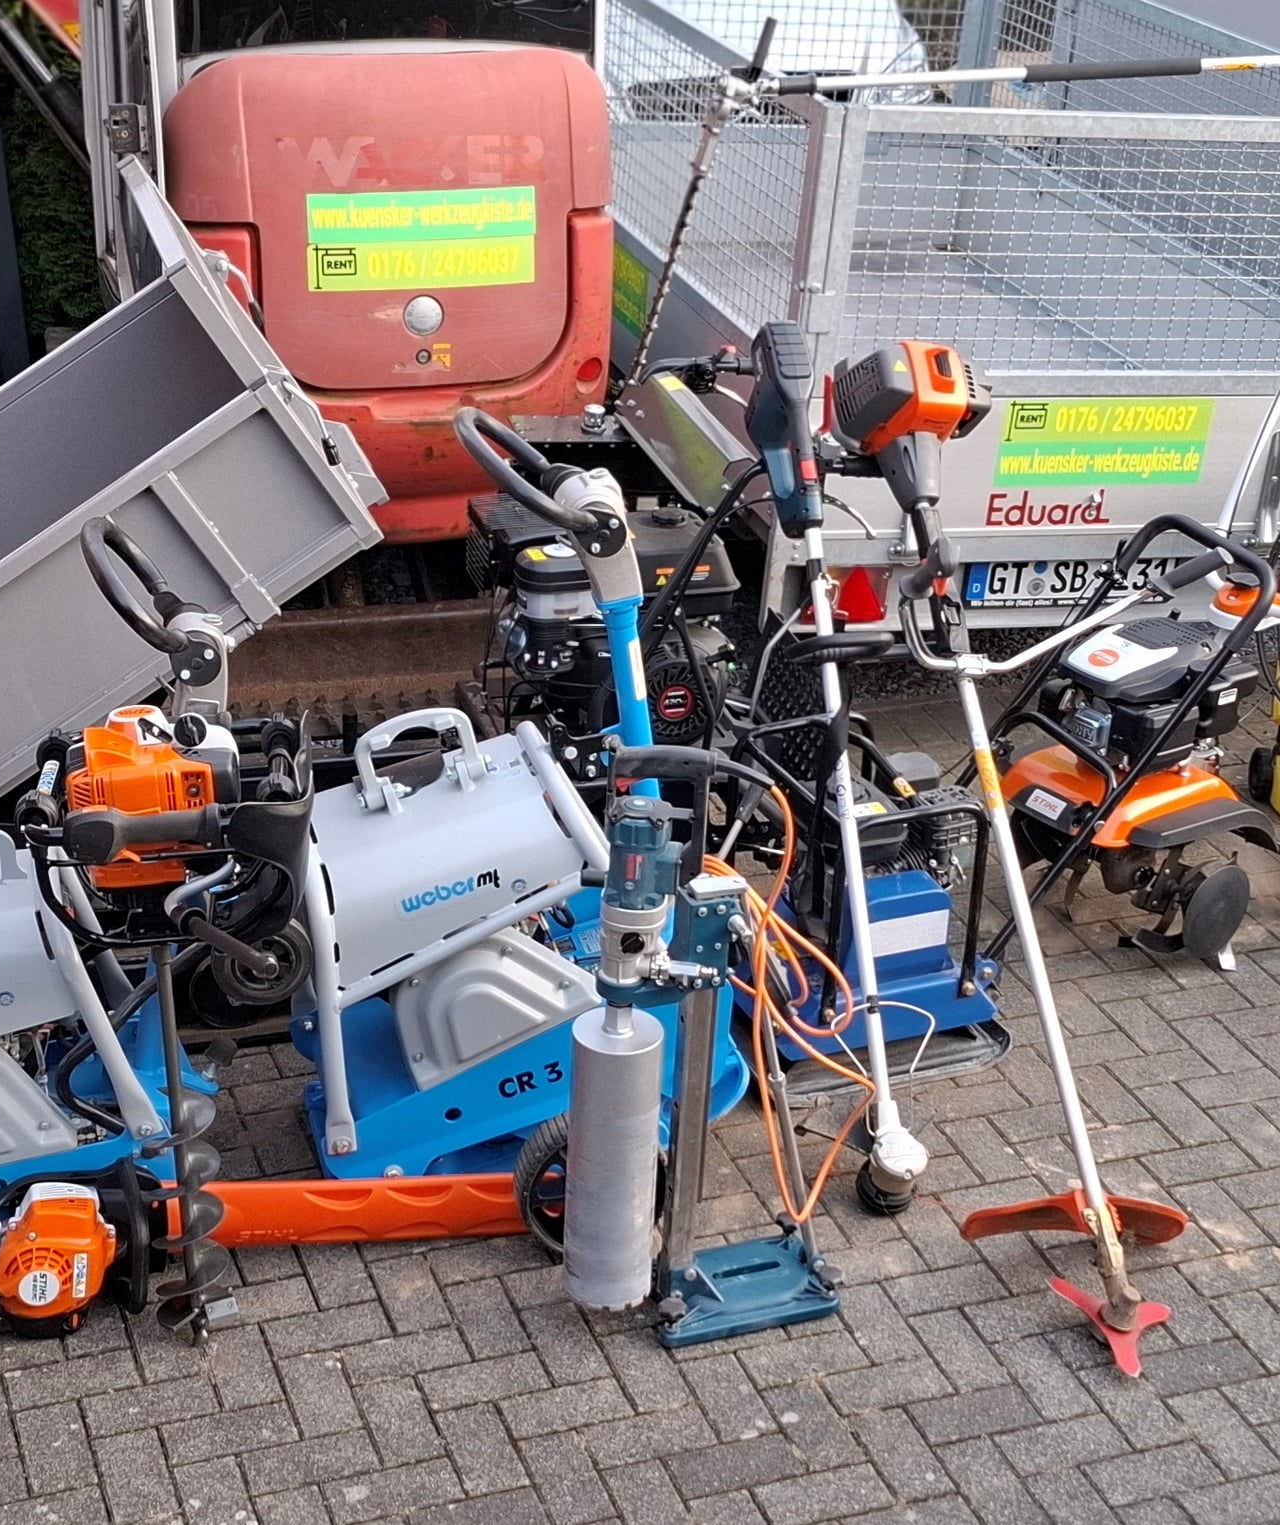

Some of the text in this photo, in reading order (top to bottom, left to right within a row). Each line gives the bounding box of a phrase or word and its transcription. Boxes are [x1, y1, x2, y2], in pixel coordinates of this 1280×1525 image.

[311, 196, 534, 232] www.kuensker-werkzeugkiste.de
[326, 260, 354, 270] RENT
[367, 250, 416, 281] 0176
[432, 245, 520, 277] 24796037
[1020, 414, 1044, 424] RENT
[1055, 407, 1096, 433] 0176
[1112, 406, 1198, 432] 24796037
[1000, 446, 1200, 478] www.kuensker-werkzeugkiste.de
[986, 489, 1110, 526] Eduard
[973, 583, 981, 593] D
[989, 562, 1029, 595] GT
[1050, 561, 1089, 593] SB
[498, 1060, 563, 1098] CR 3
[39, 1272, 48, 1302] STIHL
